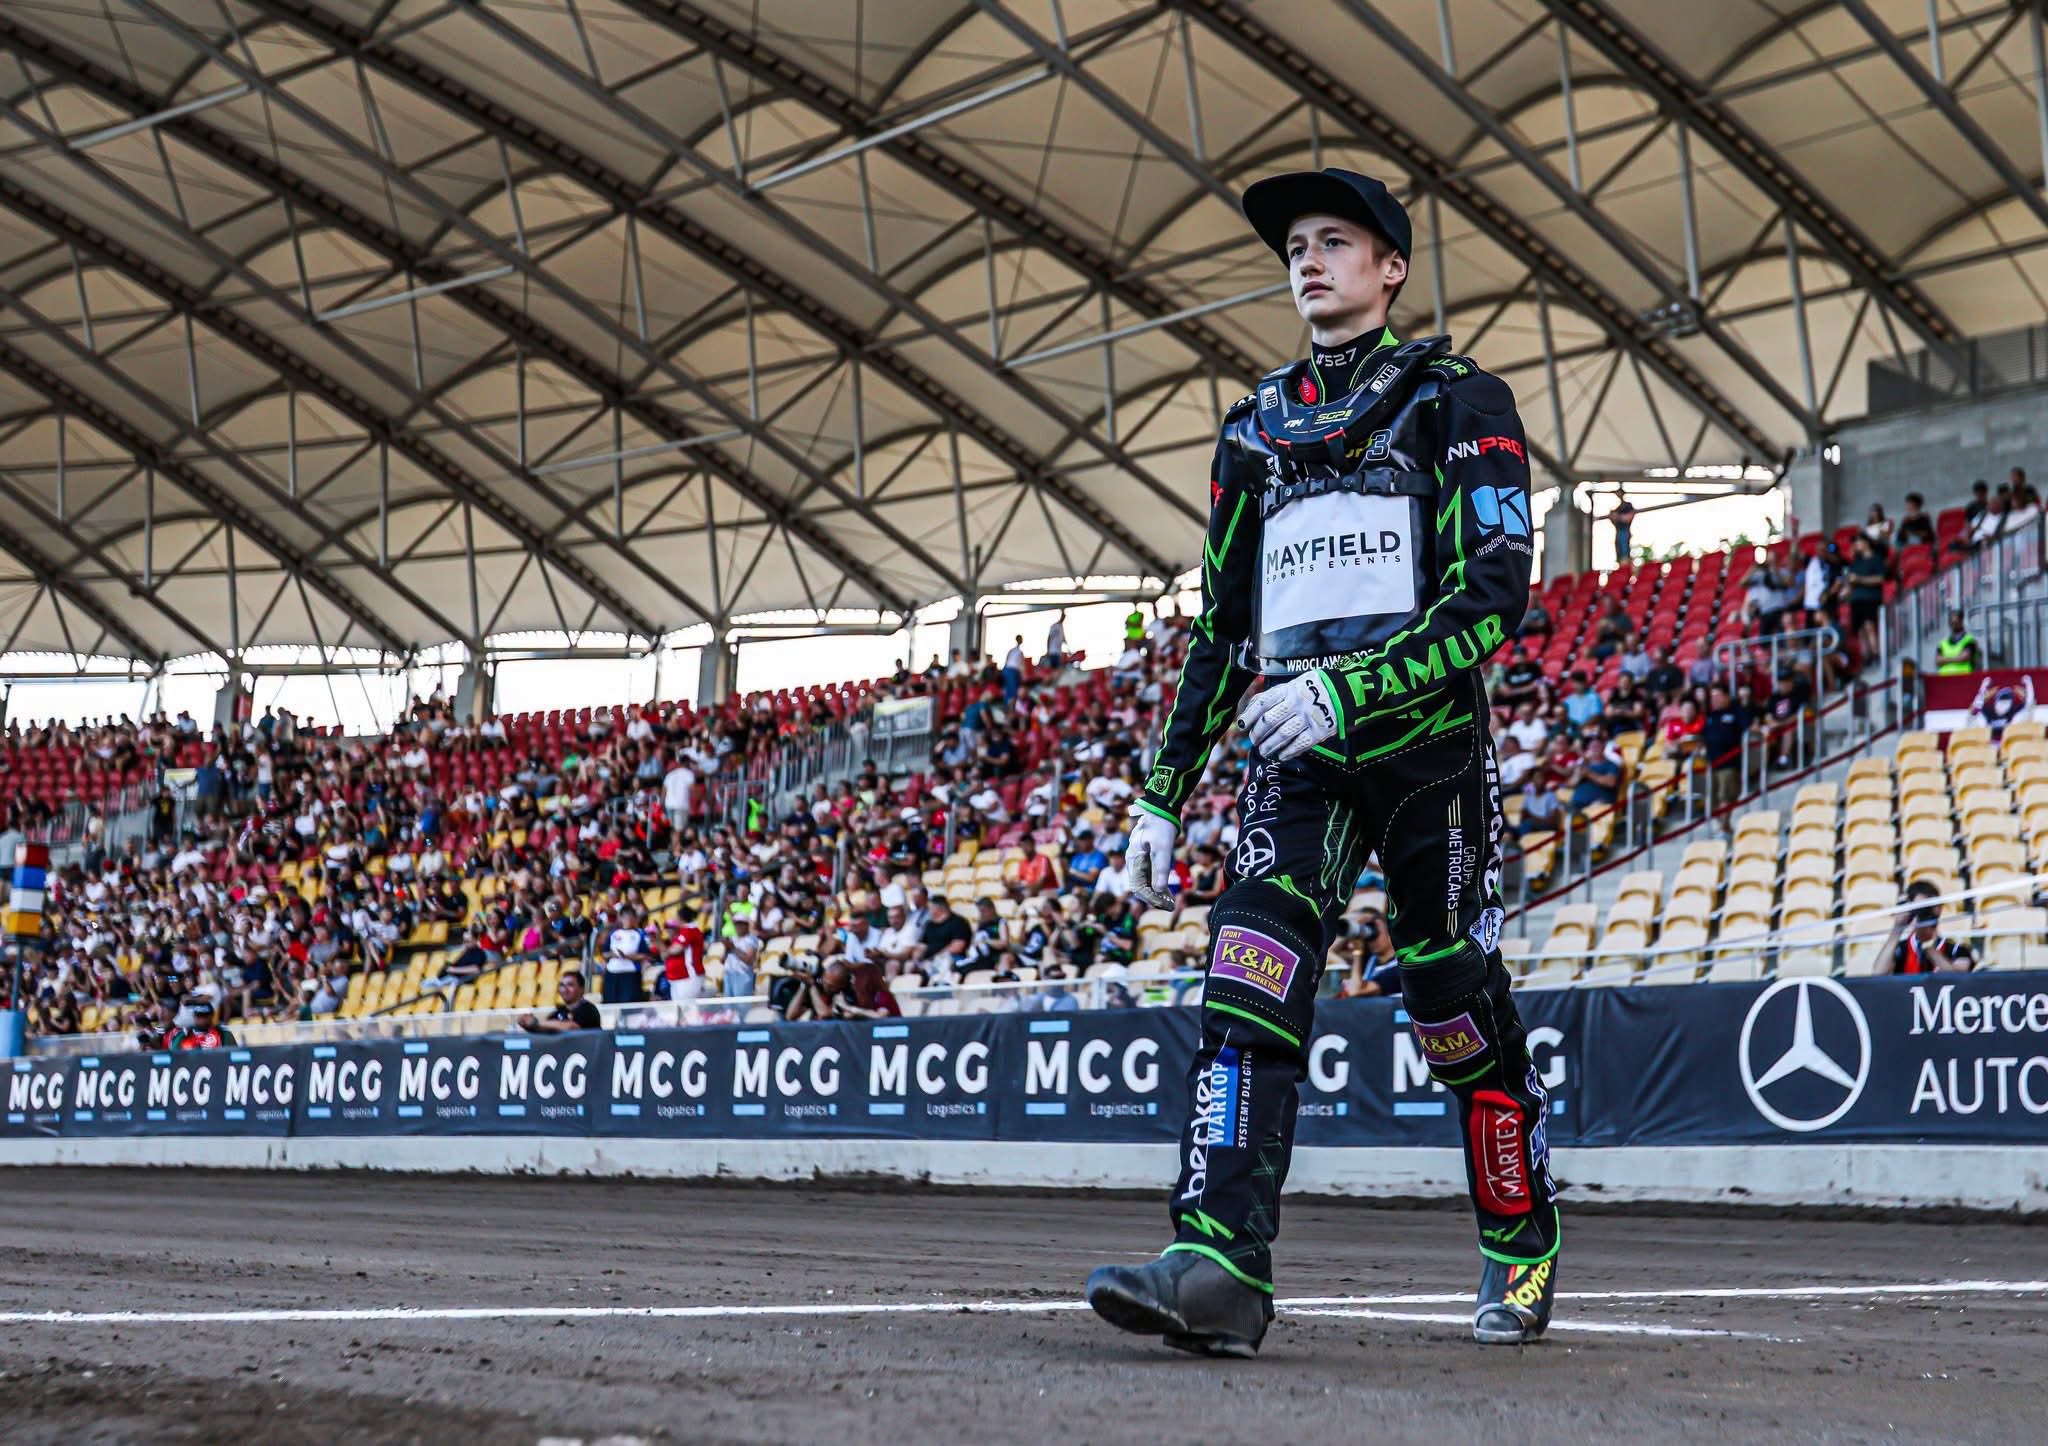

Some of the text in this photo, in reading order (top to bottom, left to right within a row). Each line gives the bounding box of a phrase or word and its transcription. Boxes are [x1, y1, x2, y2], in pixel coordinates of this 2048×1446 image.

[1315, 347, 1357, 367] #527
[1365, 428, 1393, 462] 3
[1266, 530, 1401, 575] MAYFIELD
[1266, 554, 1401, 585] SPORTS EVENTS
[1345, 614, 1506, 707] FAMUR
[1244, 765, 1264, 823] Toyoa
[1447, 828, 1463, 911] METROCARS
[1222, 930, 1242, 939] SPORT
[1221, 943, 1286, 981] K&M
[1245, 971, 1282, 994] MARKETING
[1418, 1031, 1470, 1053] K&M
[148, 1066, 212, 1107] MCG
[226, 1064, 295, 1106] MCG
[309, 1060, 384, 1105] MCG
[399, 1056, 481, 1102] MCG
[500, 1053, 588, 1100] MCG
[612, 1050, 708, 1099] MCG
[734, 1046, 842, 1098] MCG
[870, 1041, 990, 1096] MCG
[1025, 1038, 1160, 1095] MCG
[1241, 1077, 1252, 1097] DLA
[9, 1072, 64, 1111] MCG
[76, 1069, 136, 1109] MCG
[784, 1103, 827, 1117] Logistics
[1207, 1062, 1229, 1145] WARKOP
[540, 1104, 576, 1117] Logistics
[657, 1104, 696, 1118] Logistics
[927, 1103, 975, 1118] Logistics
[1090, 1102, 1145, 1119] Logistics
[1238, 1100, 1250, 1149] SYSTEMY
[1180, 1068, 1213, 1201] becker
[1494, 1109, 1525, 1198] MARTEX
[1503, 1259, 1552, 1306] ayto
